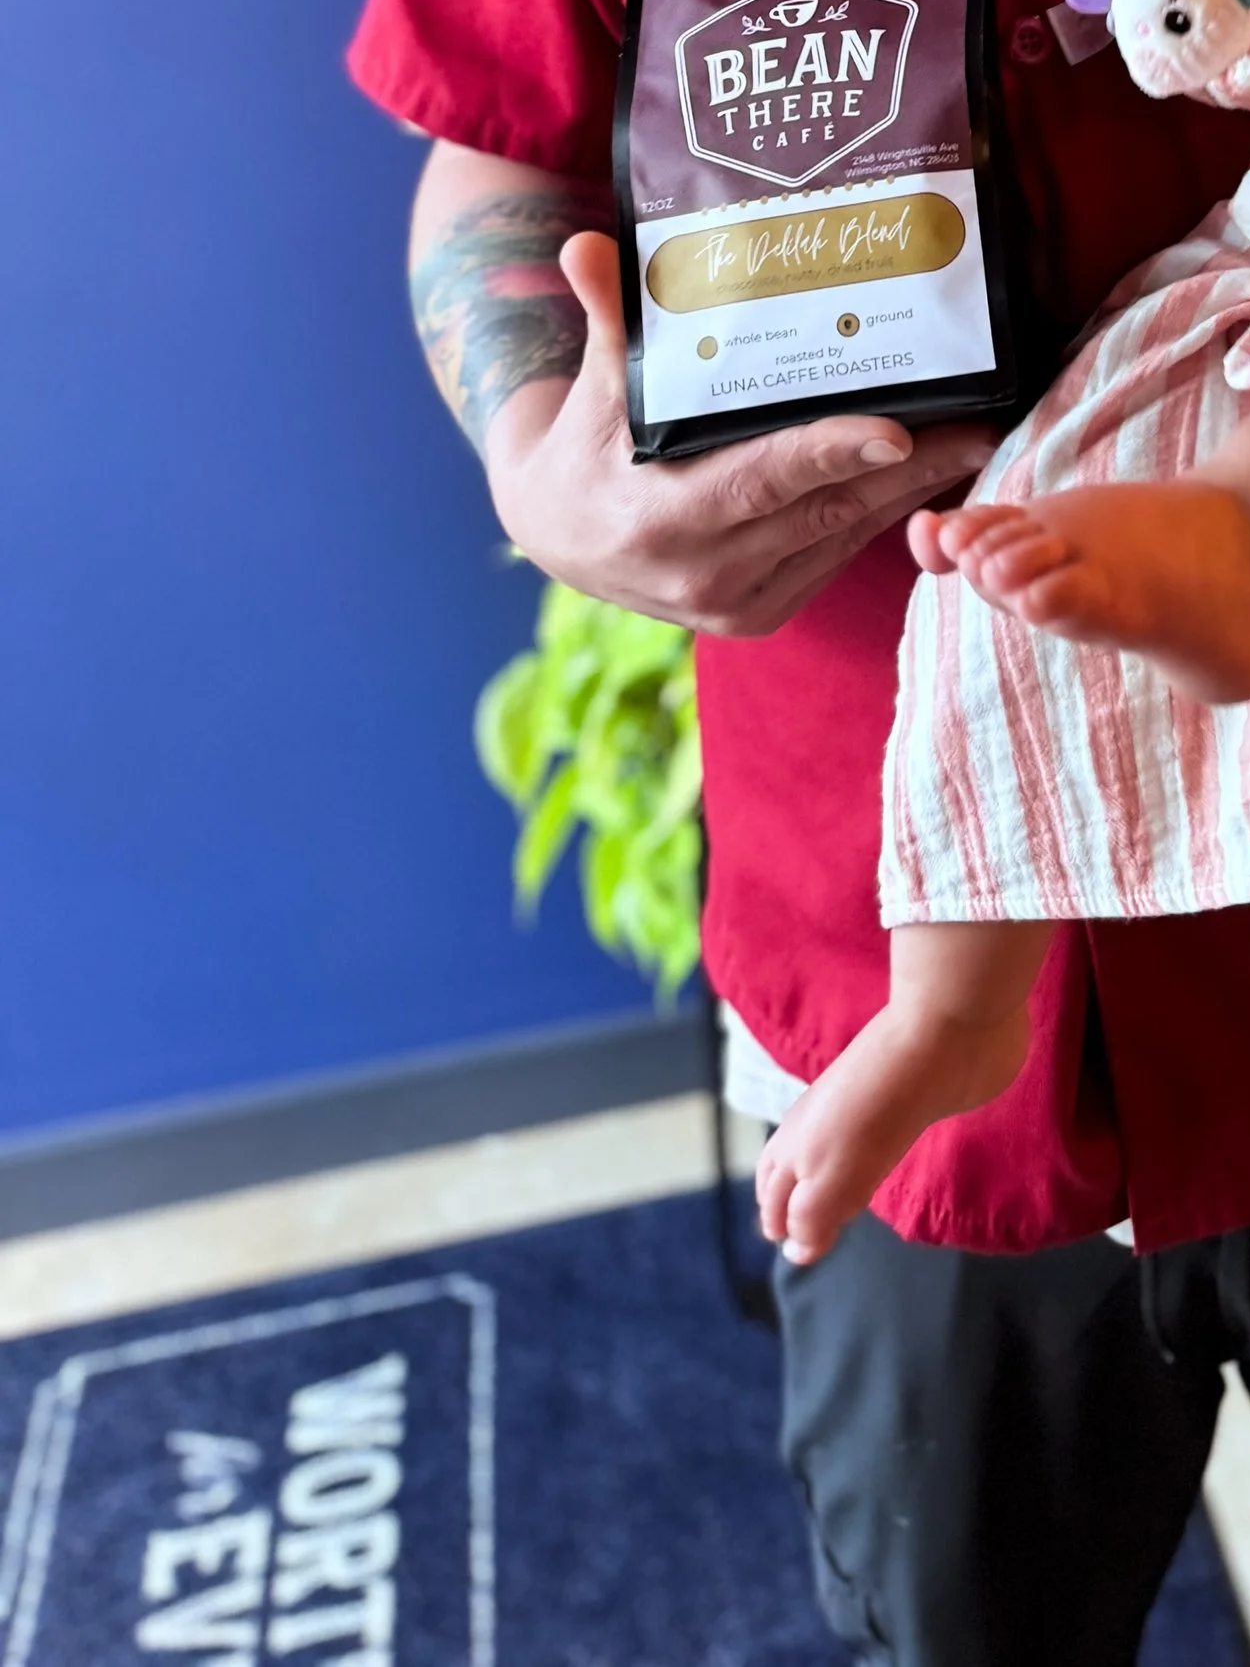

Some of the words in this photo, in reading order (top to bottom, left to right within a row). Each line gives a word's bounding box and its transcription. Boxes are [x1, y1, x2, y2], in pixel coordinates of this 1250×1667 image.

[703, 29, 887, 106] BEAN
[717, 89, 864, 135] THERE
[752, 121, 835, 151] CAFÉ
[938, 141, 959, 152] Ave
[908, 157, 925, 167] NC
[695, 232, 738, 282] The
[745, 216, 828, 276] Delilah
[839, 205, 912, 264] Blend
[865, 308, 914, 328] ground
[723, 333, 763, 348] whole
[765, 327, 798, 342] bean
[775, 347, 825, 366] roasted
[828, 345, 845, 359] by
[710, 377, 760, 397] LUNA
[763, 366, 821, 388] CAFFE
[824, 351, 915, 379] ROASTERS
